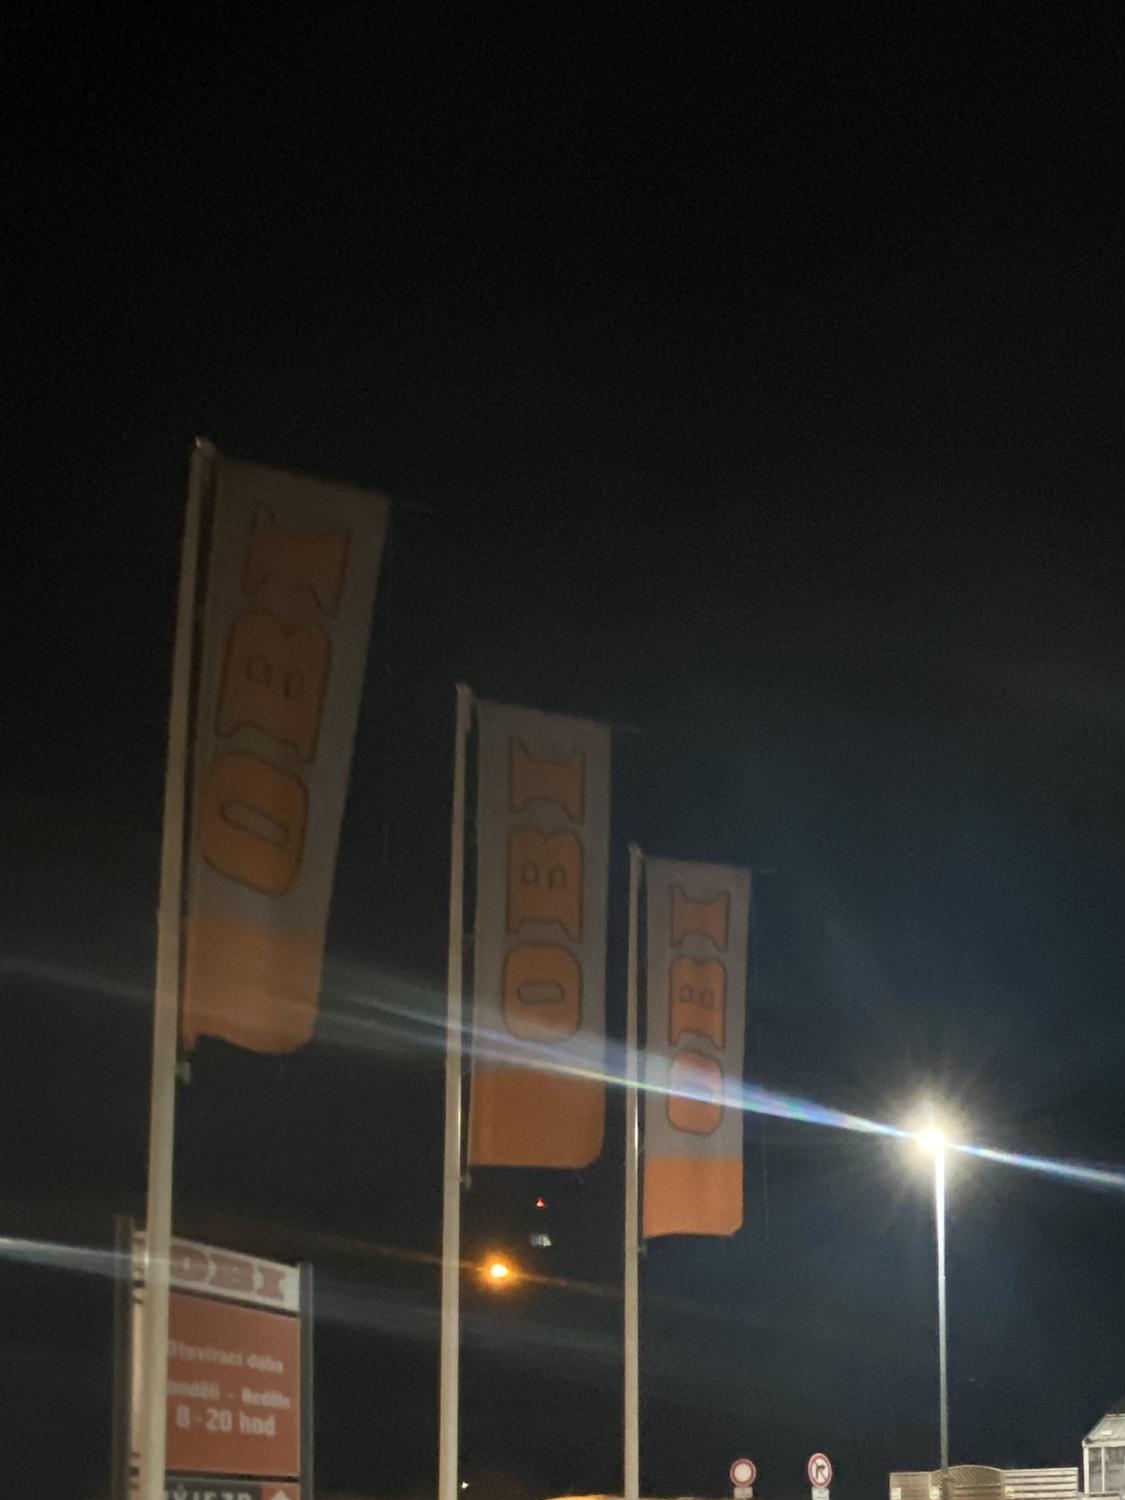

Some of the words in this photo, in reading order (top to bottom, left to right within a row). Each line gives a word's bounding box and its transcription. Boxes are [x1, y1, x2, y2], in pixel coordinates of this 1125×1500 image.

[200, 501, 352, 897] OBI
[502, 736, 585, 1043] OBI
[667, 883, 731, 1136] OBI
[170, 1243, 286, 1301] OBI
[239, 1410, 276, 1437] hod
